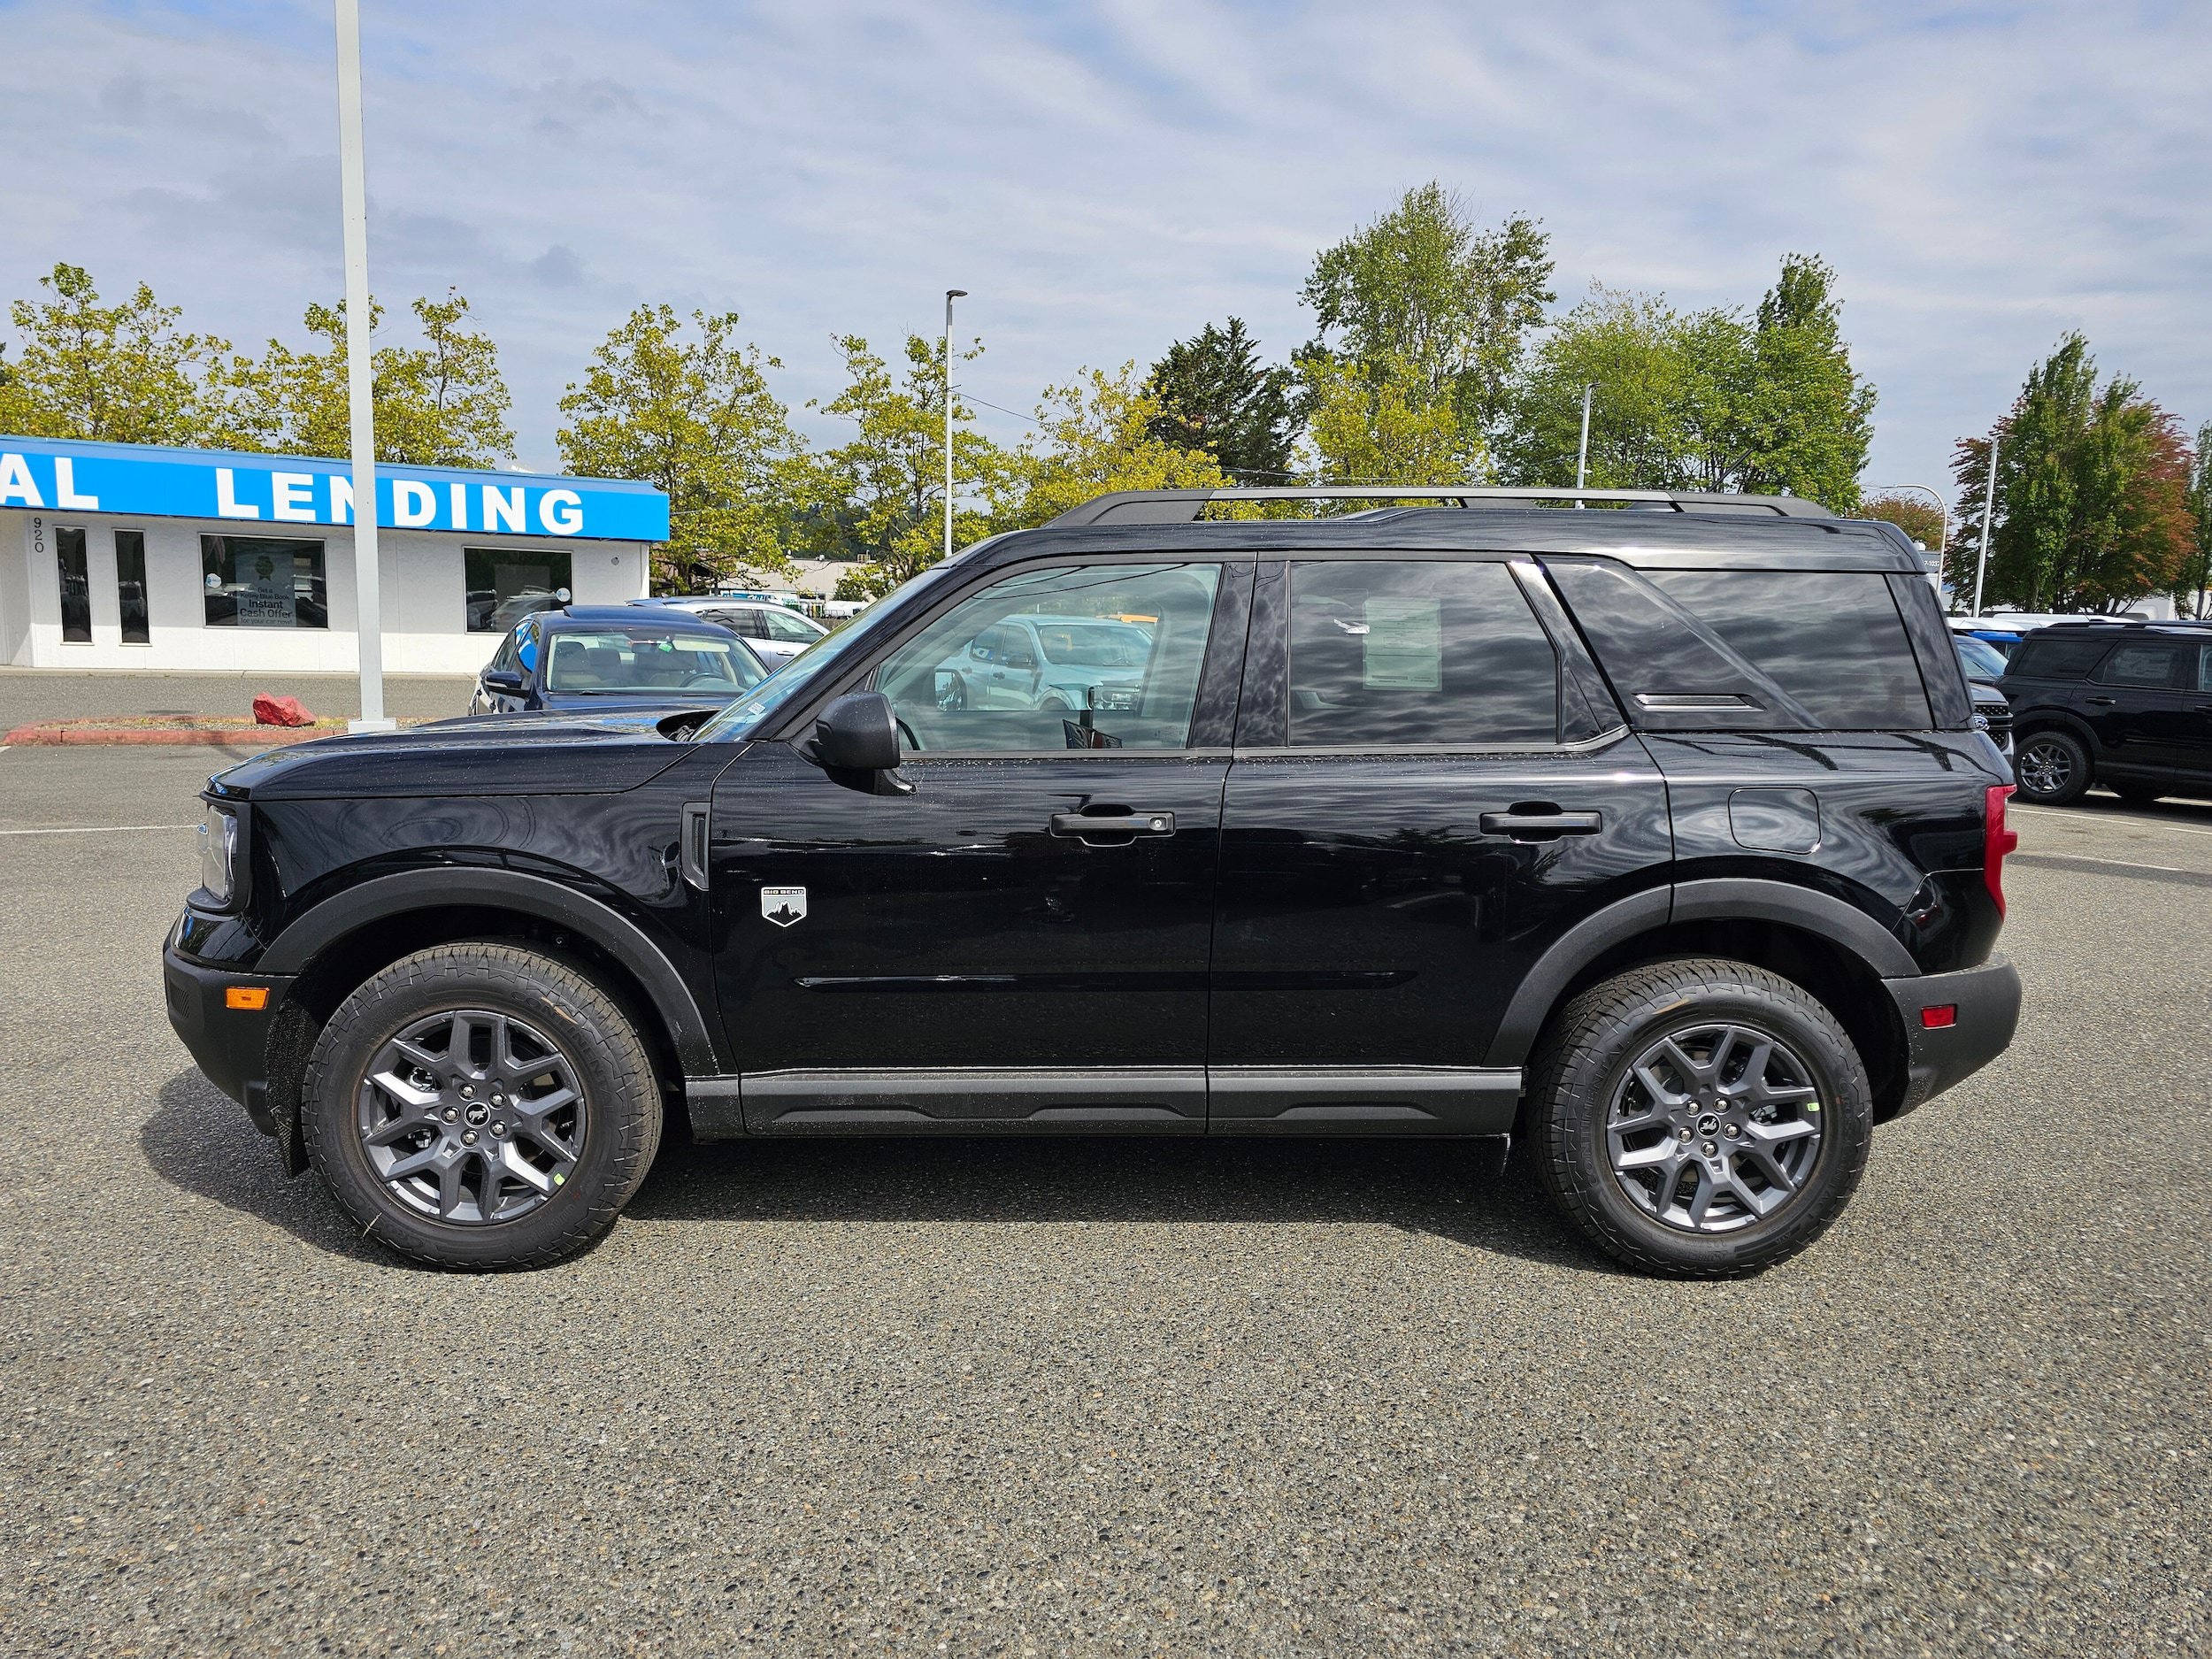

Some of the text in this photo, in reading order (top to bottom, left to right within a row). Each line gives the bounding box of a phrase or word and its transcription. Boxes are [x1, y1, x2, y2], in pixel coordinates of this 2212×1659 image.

[0, 453, 584, 536] AL LENDING
[34, 517, 44, 553] 920
[240, 608, 293, 618] Cash Offer
[249, 599, 284, 609] Instant
